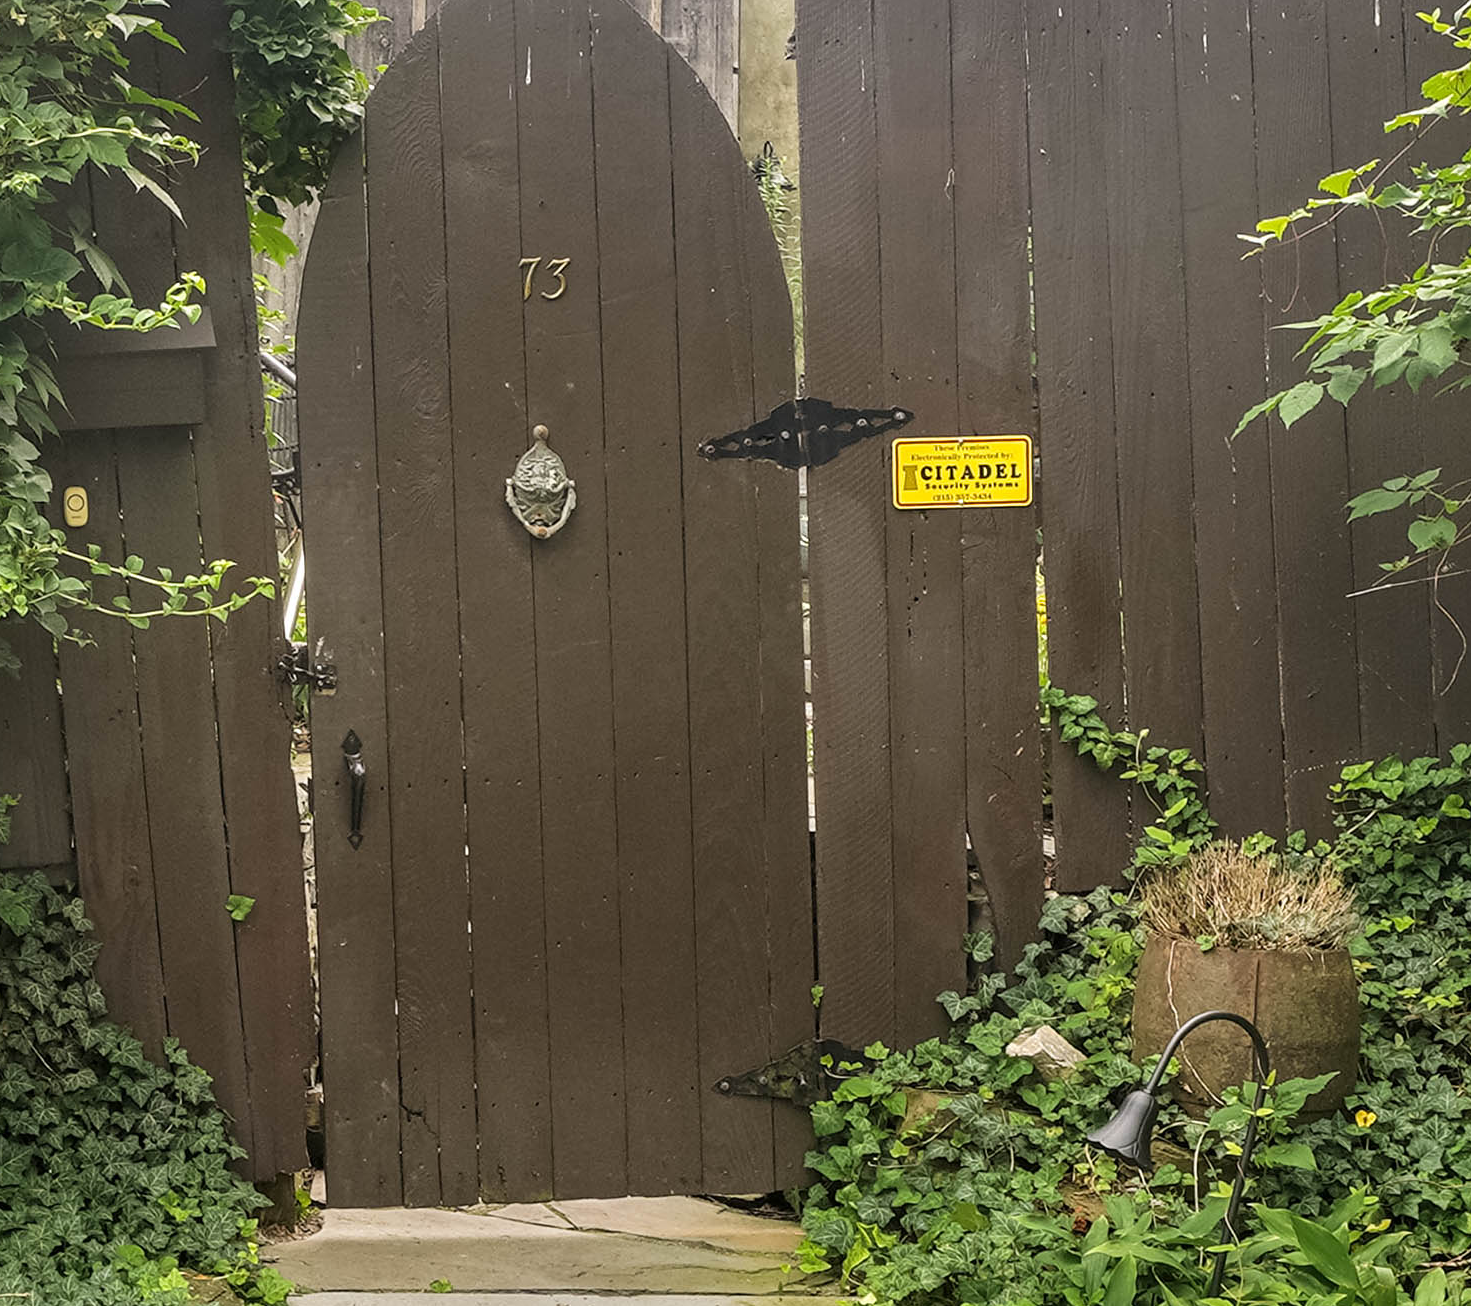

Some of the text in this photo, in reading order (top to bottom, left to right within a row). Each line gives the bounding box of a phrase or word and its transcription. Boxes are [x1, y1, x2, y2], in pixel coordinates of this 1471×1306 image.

[518, 256, 571, 300] 73
[911, 453, 961, 462] Electronically
[964, 452, 998, 460] Protected
[920, 463, 1022, 480] CITADEL
[925, 481, 1019, 490] Security Systems
